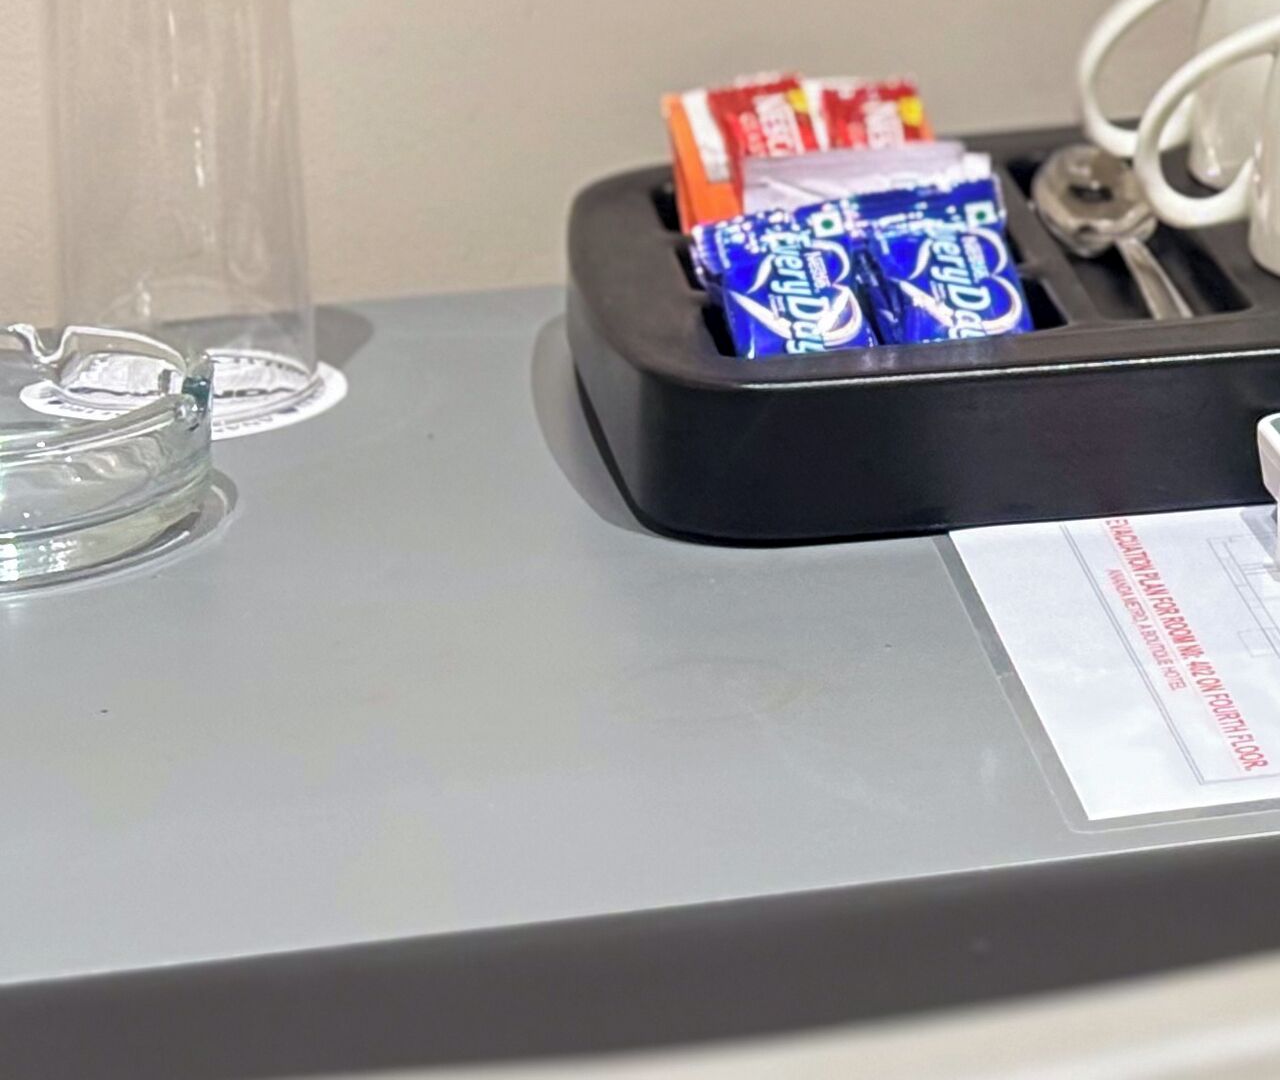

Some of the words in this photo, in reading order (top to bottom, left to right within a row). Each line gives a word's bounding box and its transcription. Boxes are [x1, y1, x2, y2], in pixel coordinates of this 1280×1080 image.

[1105, 519, 1156, 572] EVACUATION
[1134, 571, 1169, 596] PLAN
[1148, 596, 1180, 616] FOR
[1160, 615, 1196, 644] ROOM
[1140, 630, 1174, 666] BOUTIQUE
[1160, 665, 1187, 691] HOTEL
[1187, 661, 1216, 677] 402
[1196, 677, 1226, 693] ON
[1203, 693, 1249, 734] FOURTH
